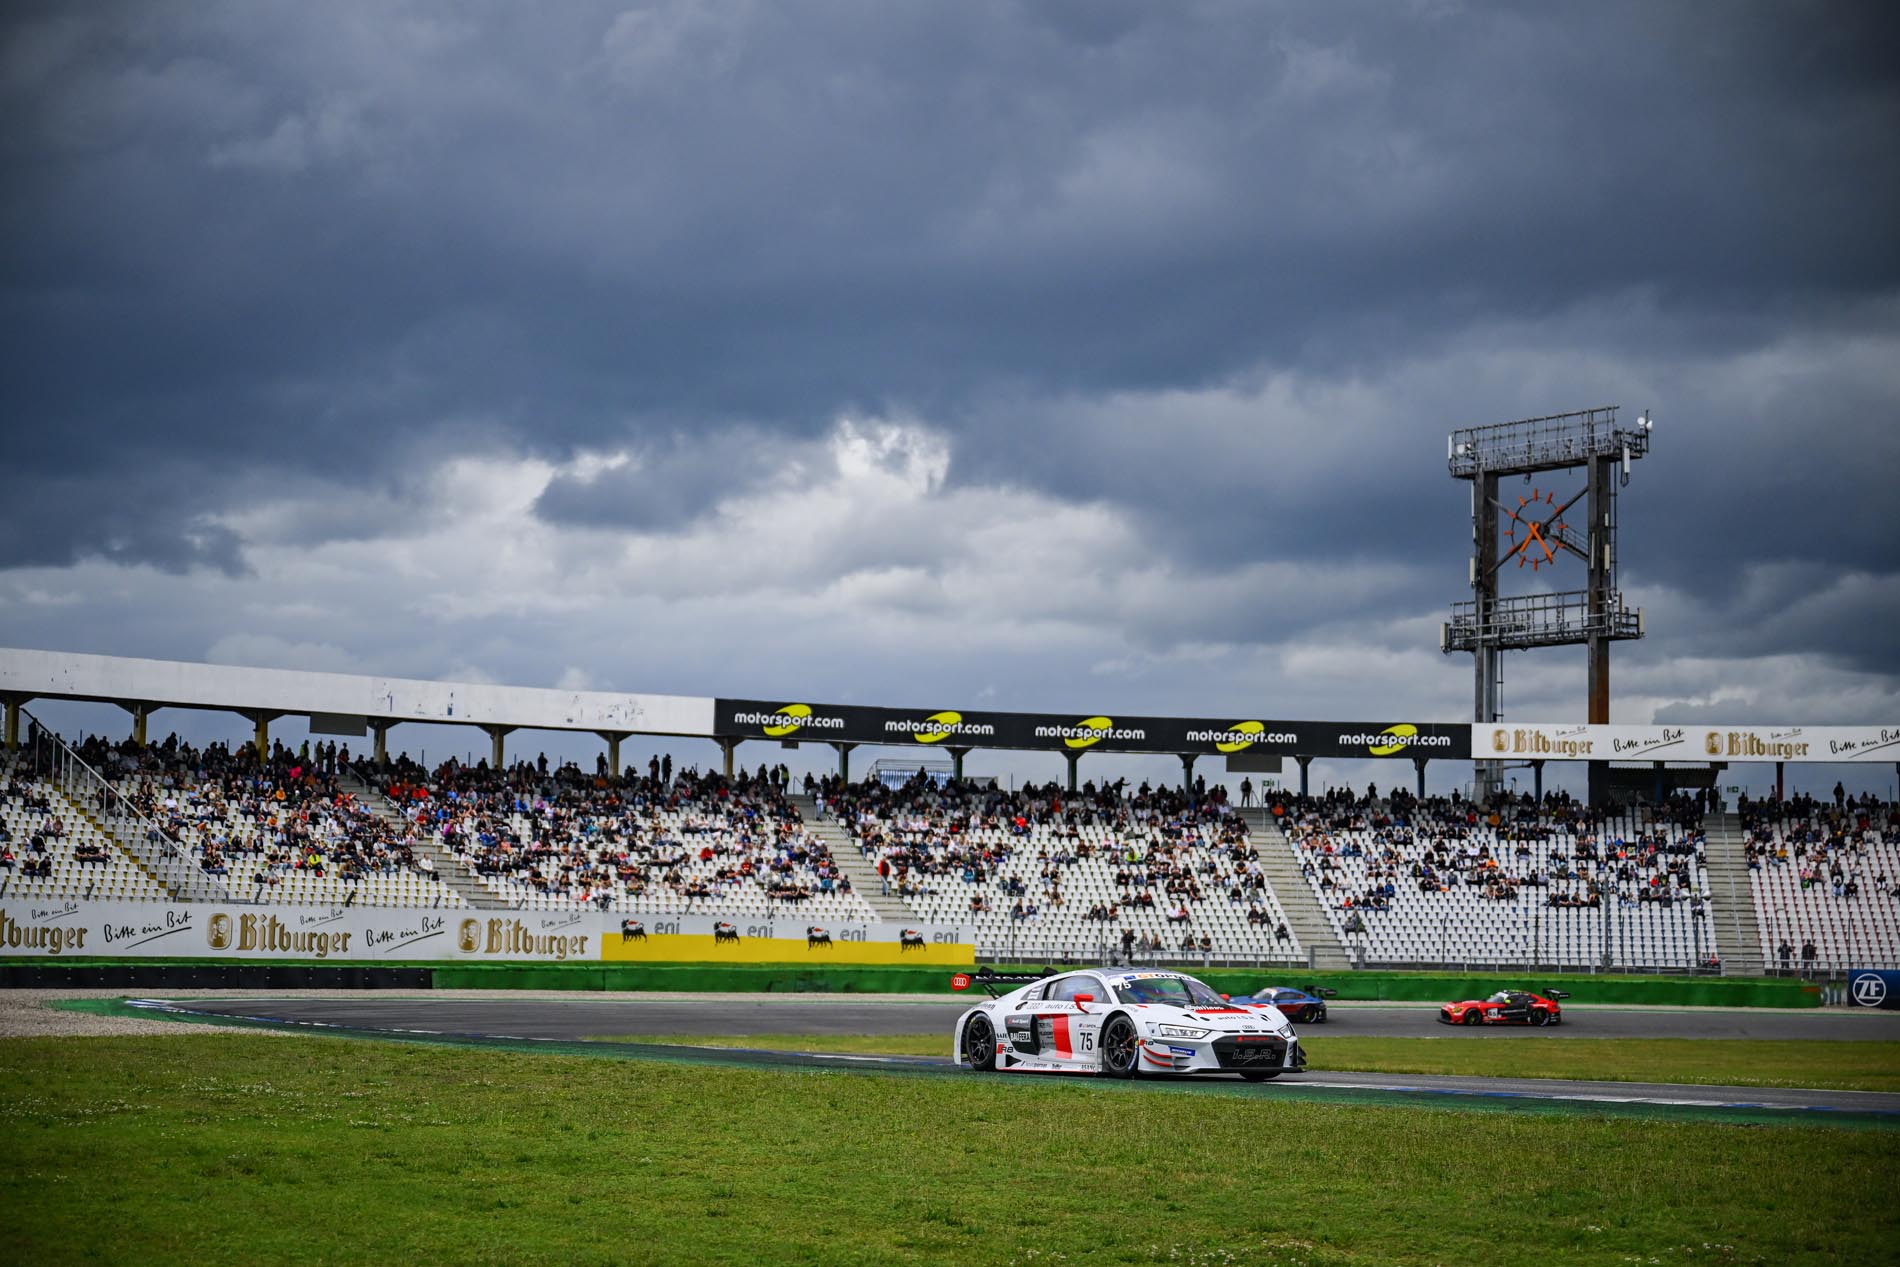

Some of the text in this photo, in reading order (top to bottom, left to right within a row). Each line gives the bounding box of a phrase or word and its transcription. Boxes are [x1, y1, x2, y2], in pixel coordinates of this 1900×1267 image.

[735, 711, 844, 730] motorsport.com
[885, 718, 994, 737] motorsport.com
[1035, 724, 1145, 742] motorsport.com
[1187, 728, 1297, 746] motorsport.com
[1339, 732, 1450, 749] motorsport.com
[1614, 729, 1684, 752] Bitte ein Bit
[1513, 729, 1593, 757] Bitburger
[1727, 732, 1809, 759] Bitburger
[1830, 740, 1857, 754] Bitte
[1862, 739, 1877, 747] ein
[104, 911, 192, 943] Bitte ein Bit
[236, 912, 352, 958] Bitburger
[366, 916, 445, 947] Bitte ein Bit
[655, 916, 680, 935] eni
[748, 921, 773, 939] eni
[840, 924, 867, 942] eni
[484, 917, 589, 960] Bitburger
[934, 927, 960, 945] eni
[1118, 982, 1132, 991] 75
[1080, 1032, 1093, 1051] 75
